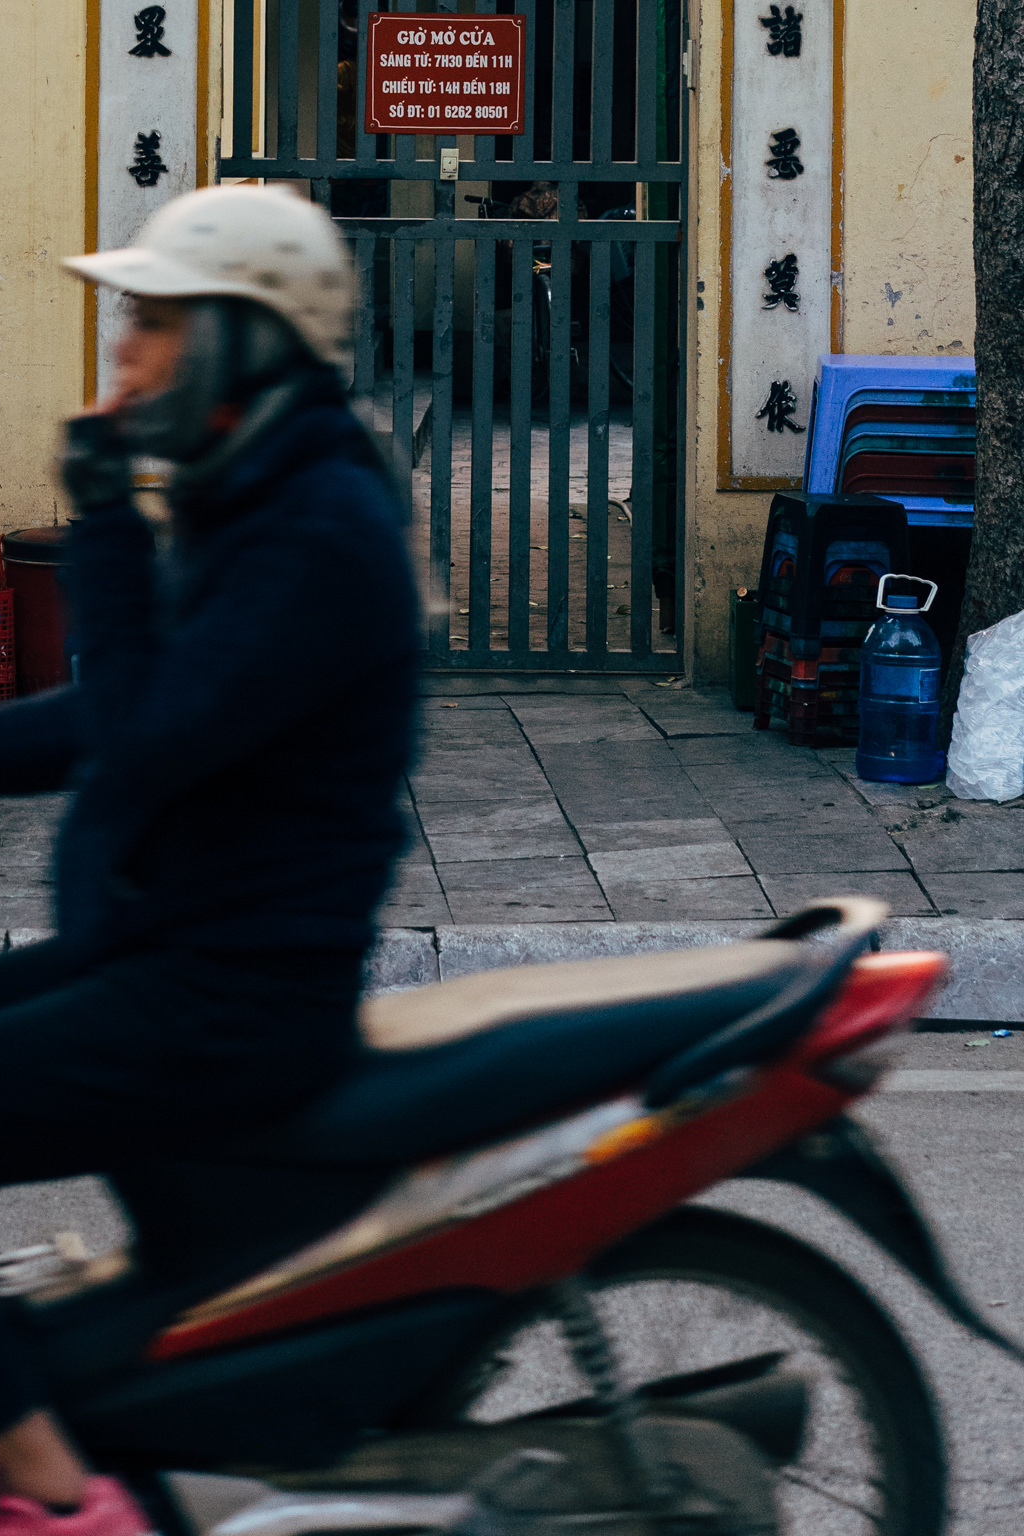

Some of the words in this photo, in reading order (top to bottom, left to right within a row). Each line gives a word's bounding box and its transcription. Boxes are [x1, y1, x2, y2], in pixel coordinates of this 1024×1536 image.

[397, 26, 427, 45] GIỜ
[430, 26, 457, 45] MỞ
[459, 26, 495, 46] CỬA
[380, 51, 411, 67] SÁNG
[414, 51, 432, 67] TỪ:
[434, 55, 463, 68] 7H30
[465, 51, 488, 68] ĐẾN
[491, 55, 513, 68] 11H
[382, 76, 415, 94] CHIỀU
[418, 78, 437, 95] TỪ:
[439, 82, 460, 95] 14H
[463, 77, 486, 95] ĐẾN
[489, 82, 511, 95] 18H
[389, 100, 405, 118] SỐ
[407, 105, 425, 118] ĐT:
[427, 105, 441, 118] 01
[444, 105, 472, 119] 6262
[475, 106, 508, 119] 80501
